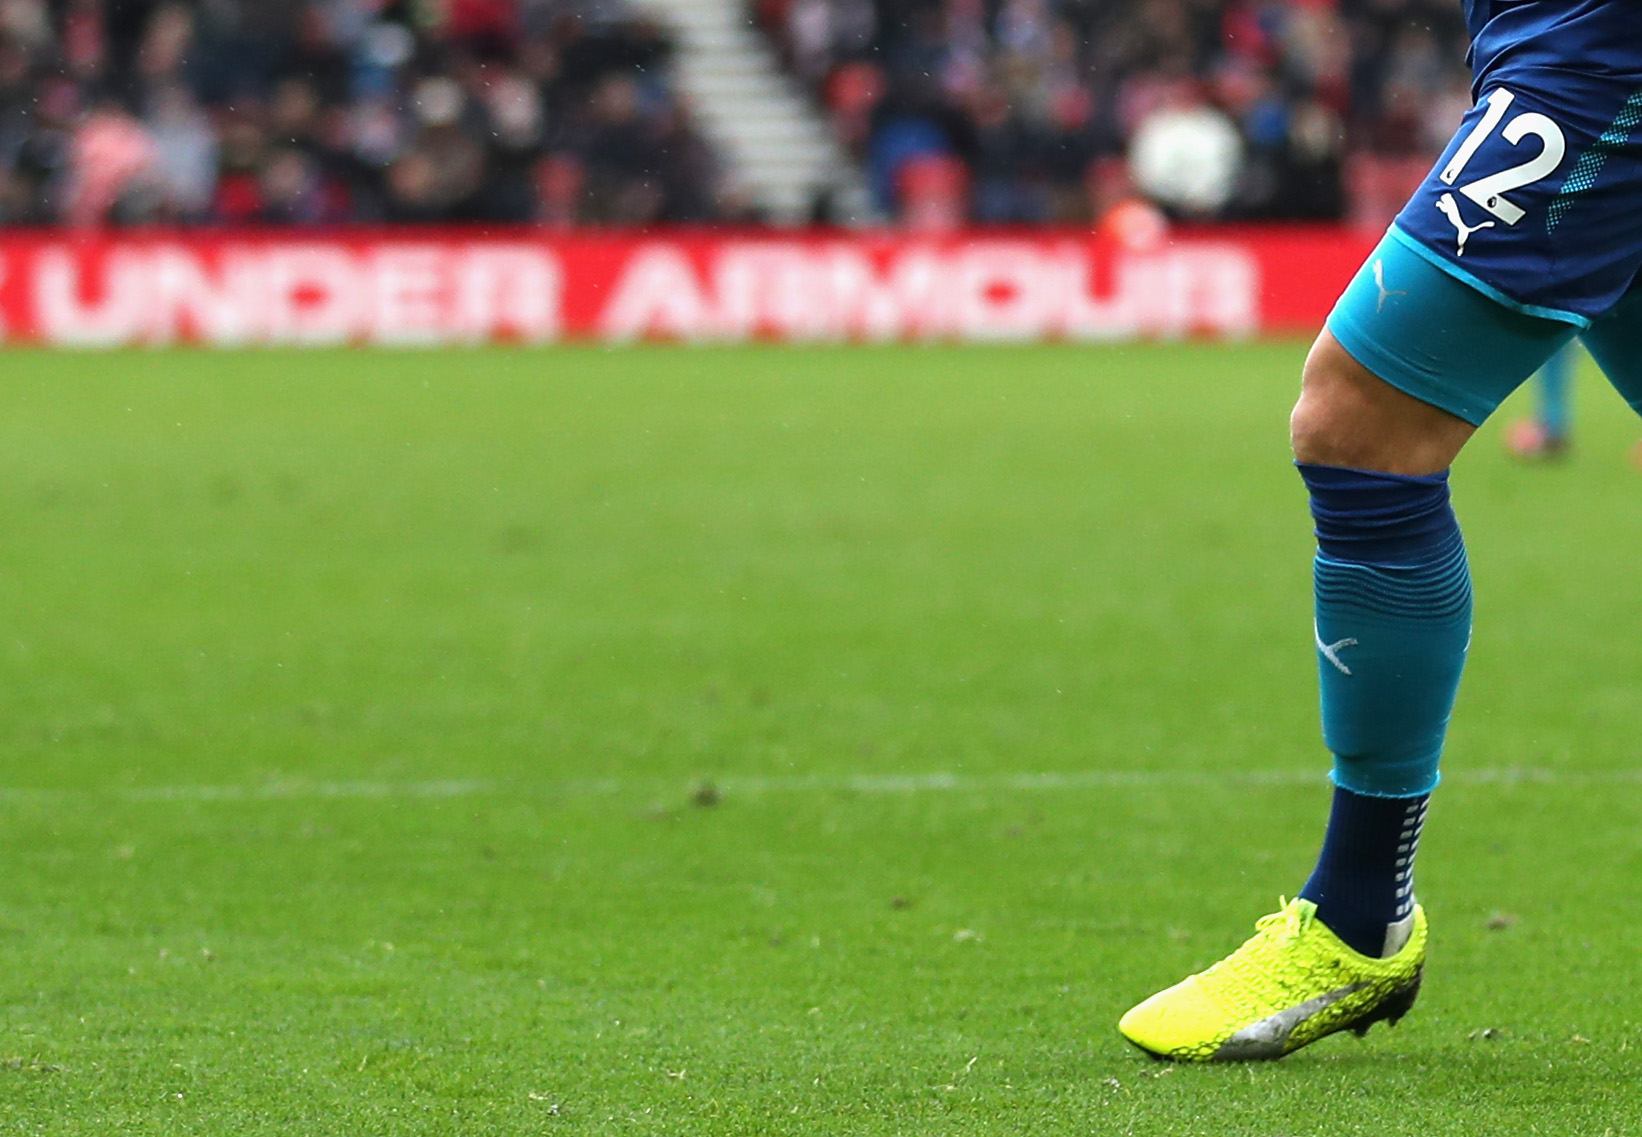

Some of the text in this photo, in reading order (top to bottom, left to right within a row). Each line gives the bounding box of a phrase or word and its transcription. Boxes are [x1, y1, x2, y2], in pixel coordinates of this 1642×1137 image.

[1439, 87, 1566, 226] 12
[32, 240, 1258, 346] UNDER ARMOUR
